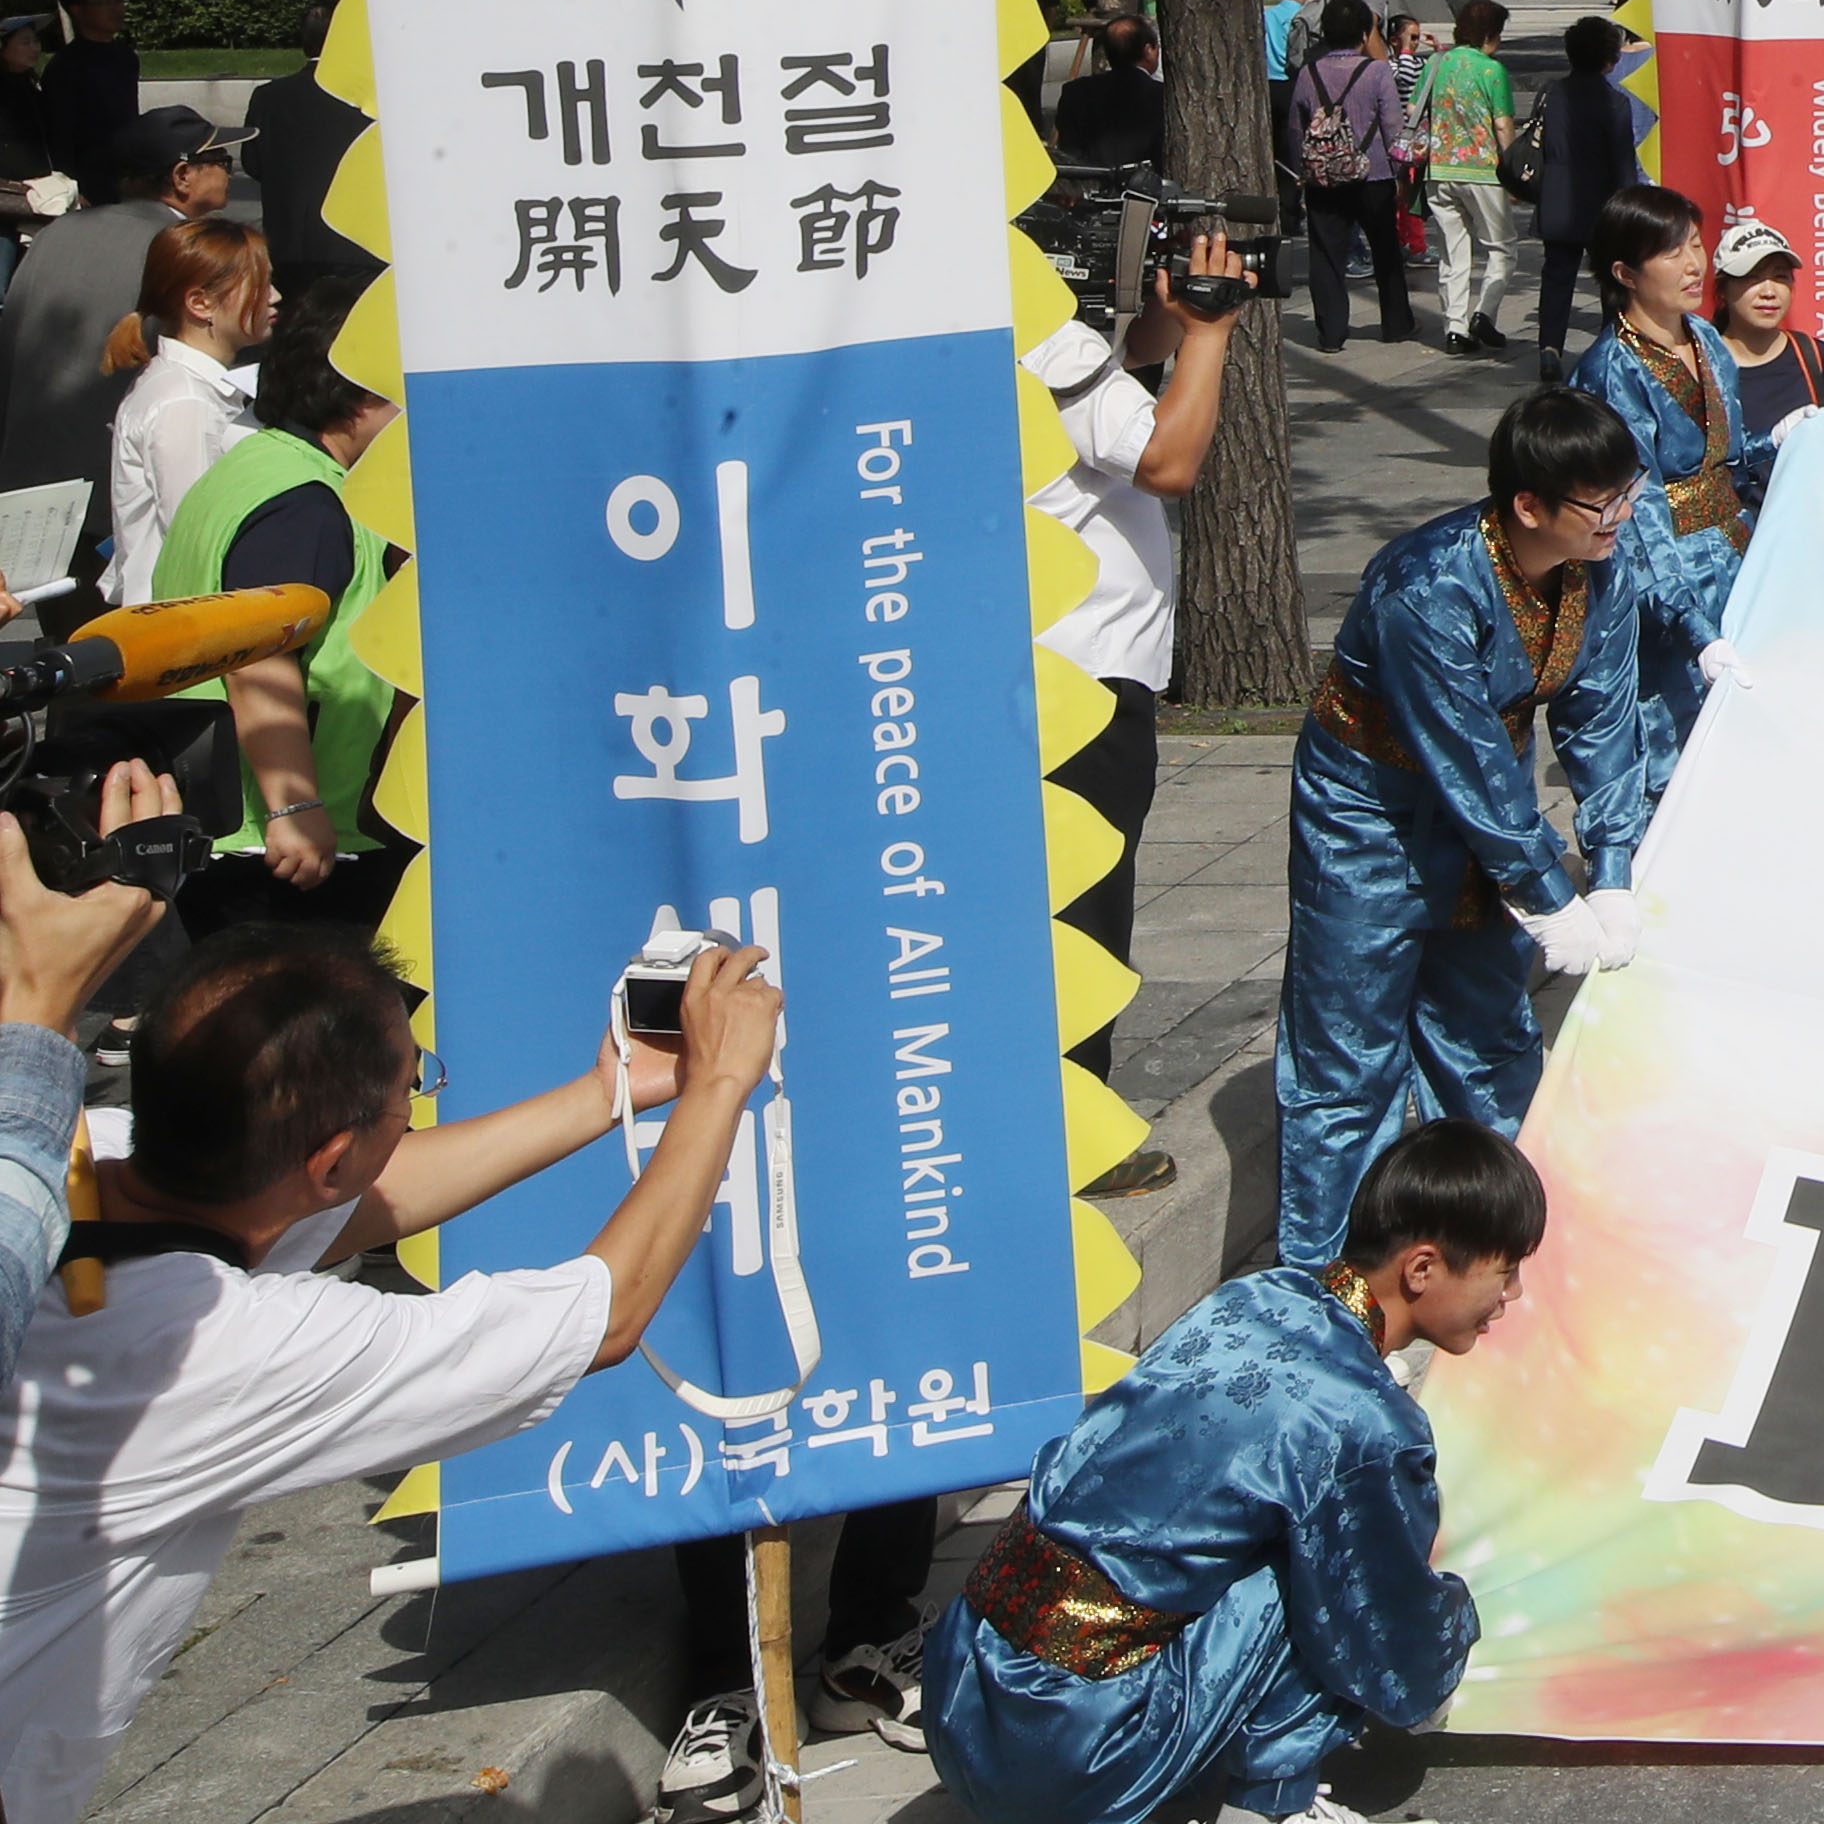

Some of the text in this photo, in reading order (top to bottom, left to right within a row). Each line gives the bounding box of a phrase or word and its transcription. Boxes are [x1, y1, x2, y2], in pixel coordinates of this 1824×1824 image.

[481, 43, 895, 167] 개천절
[504, 179, 902, 295] 開天節
[135, 842, 174, 856] Canon
[856, 418, 971, 1280] For the peace of All Mankind
[775, 1170, 785, 1229] SAMSUNG
[548, 1360, 995, 1513] (사)국학원
